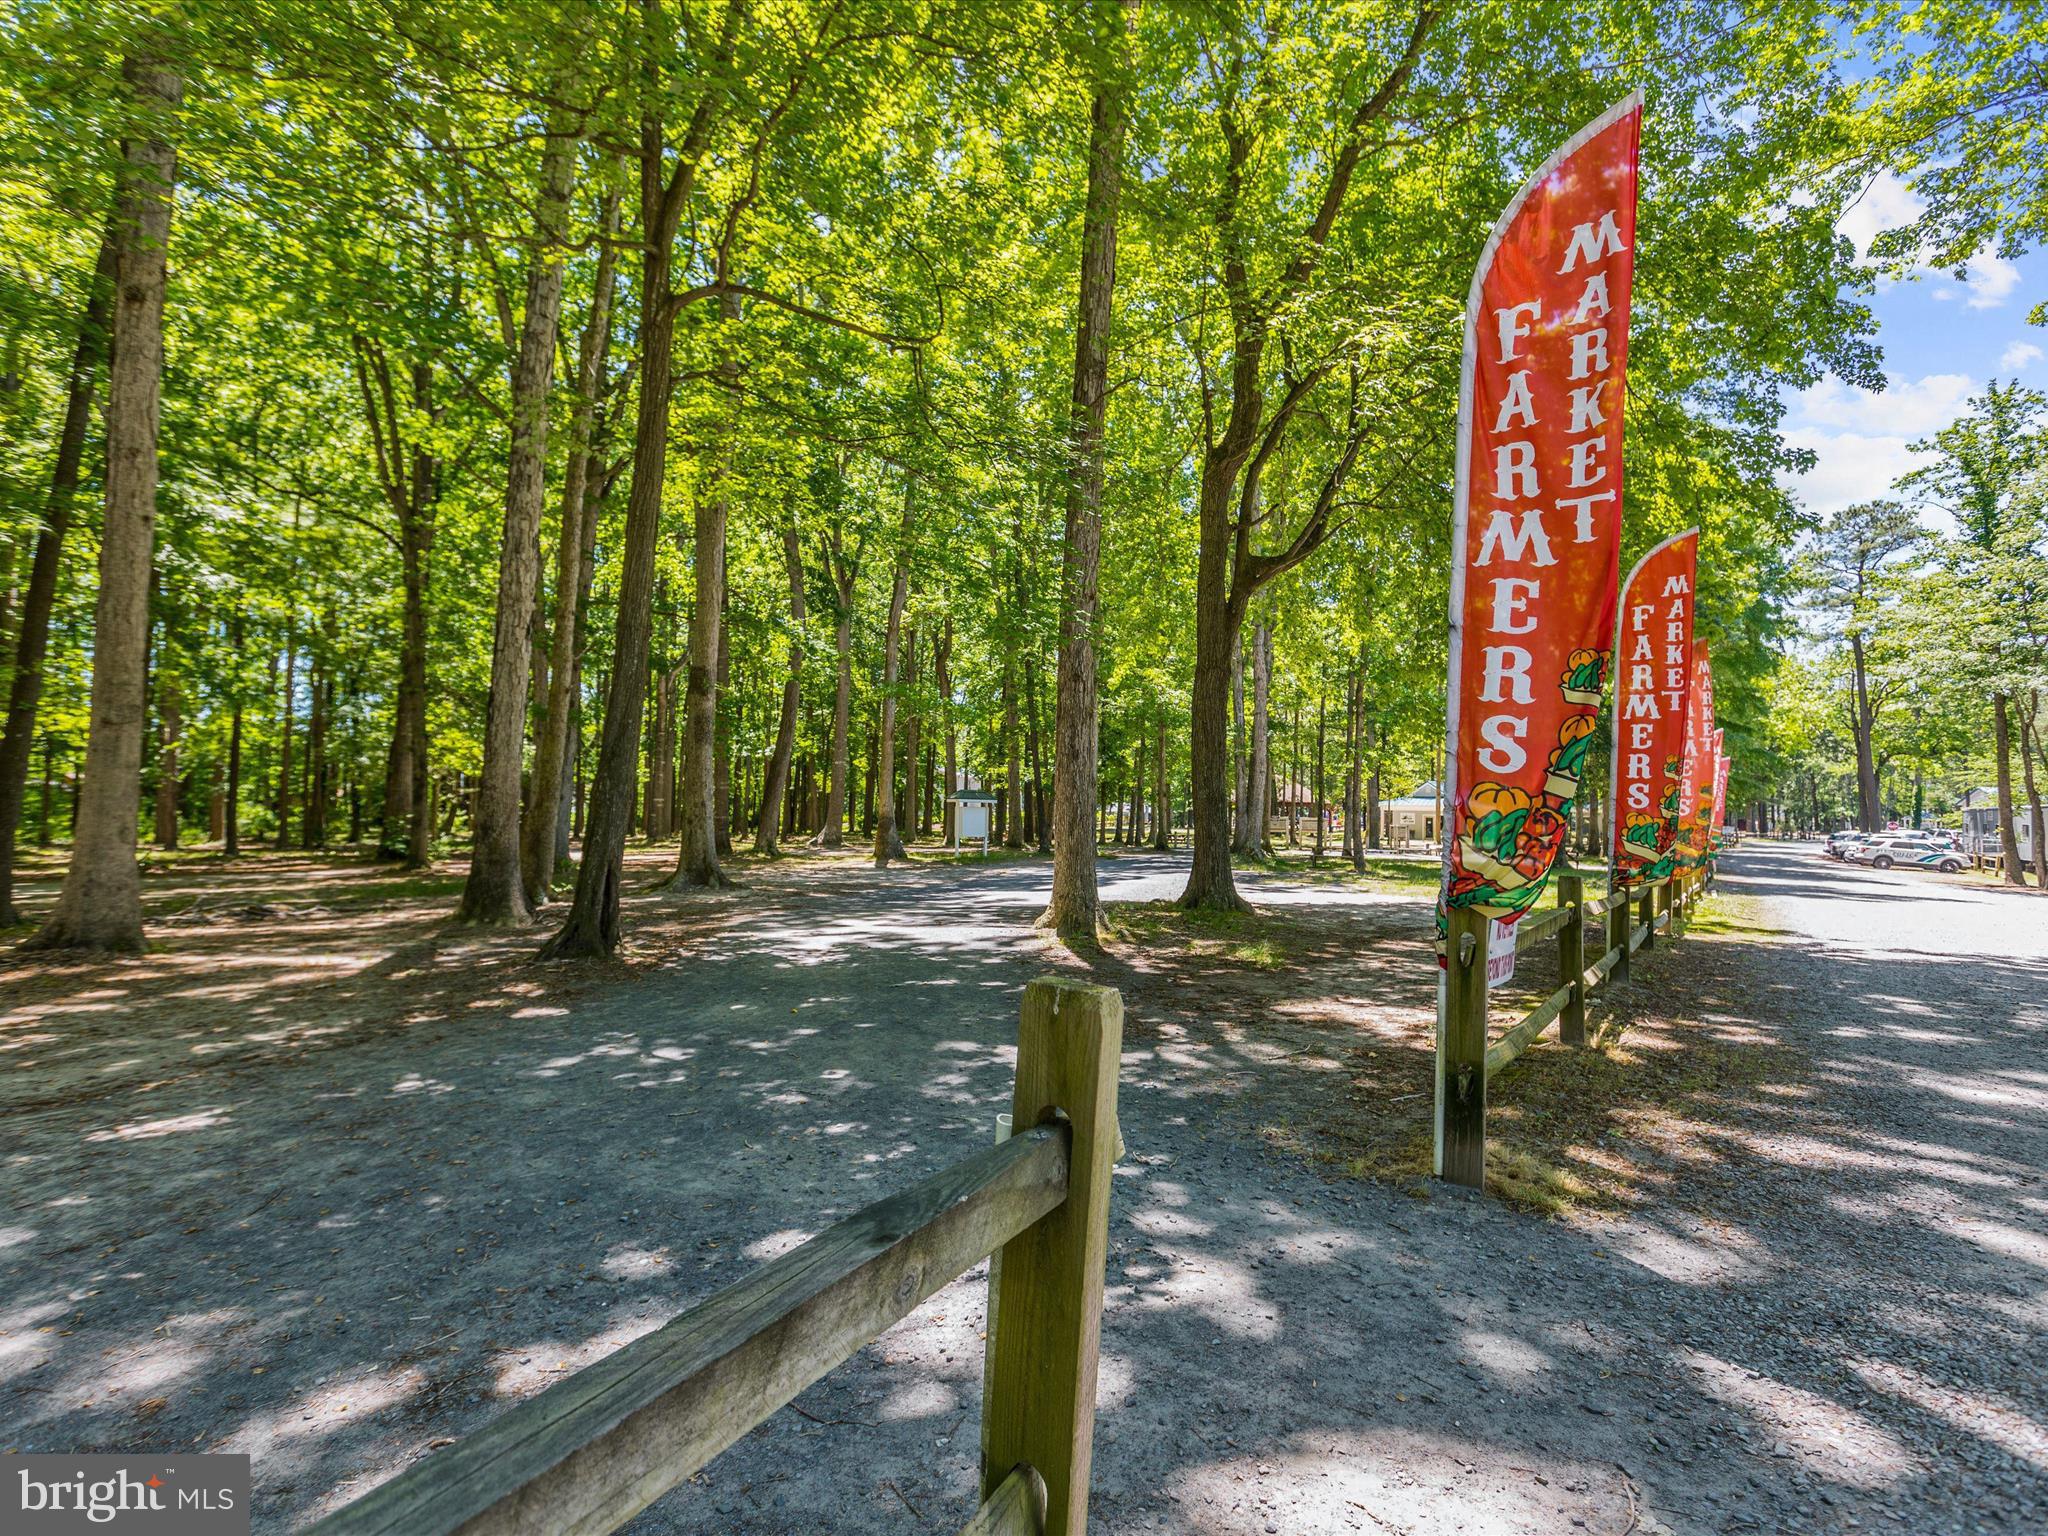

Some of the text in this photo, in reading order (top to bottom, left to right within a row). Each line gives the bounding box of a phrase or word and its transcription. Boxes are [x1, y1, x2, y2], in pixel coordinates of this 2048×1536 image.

[1554, 208, 1629, 544] MARKET
[1471, 297, 1560, 775] FARMERS
[1622, 604, 1662, 809] FARMERS
[1661, 574, 1691, 712] MARKET
[1697, 660, 1714, 752] MARKET
